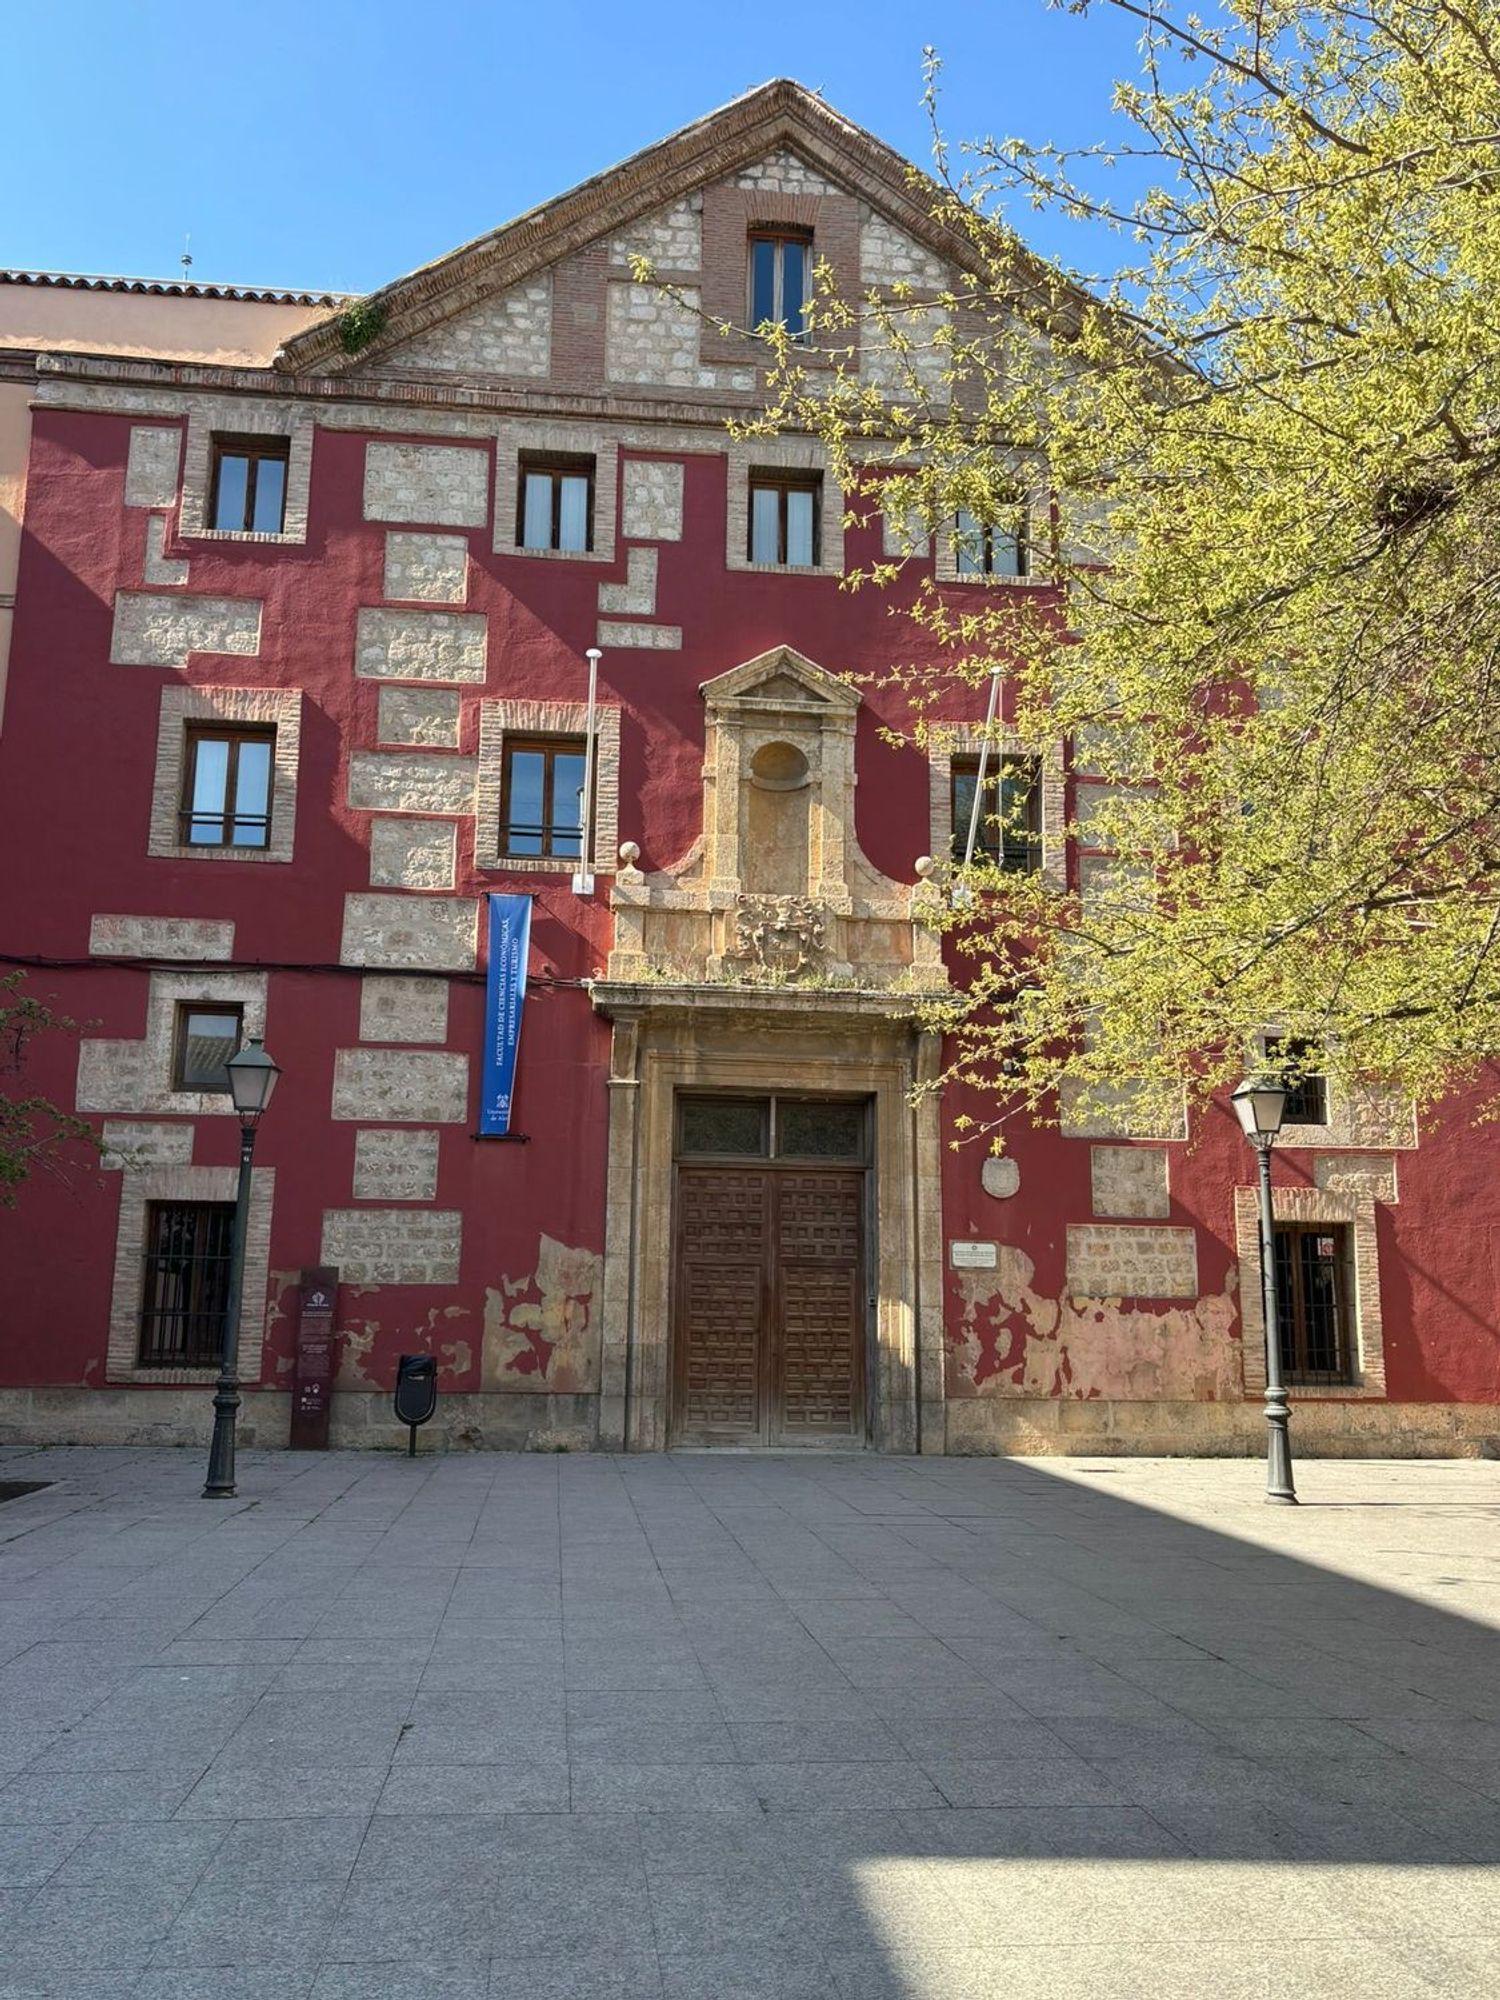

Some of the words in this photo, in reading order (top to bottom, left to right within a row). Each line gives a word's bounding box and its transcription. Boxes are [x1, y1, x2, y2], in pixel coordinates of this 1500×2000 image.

[511, 938, 519, 974] TURISMO
[498, 1010, 505, 1023] DE
[508, 983, 517, 1046] EMPRESARIALES
[496, 1023, 505, 1067] FACULTAD
